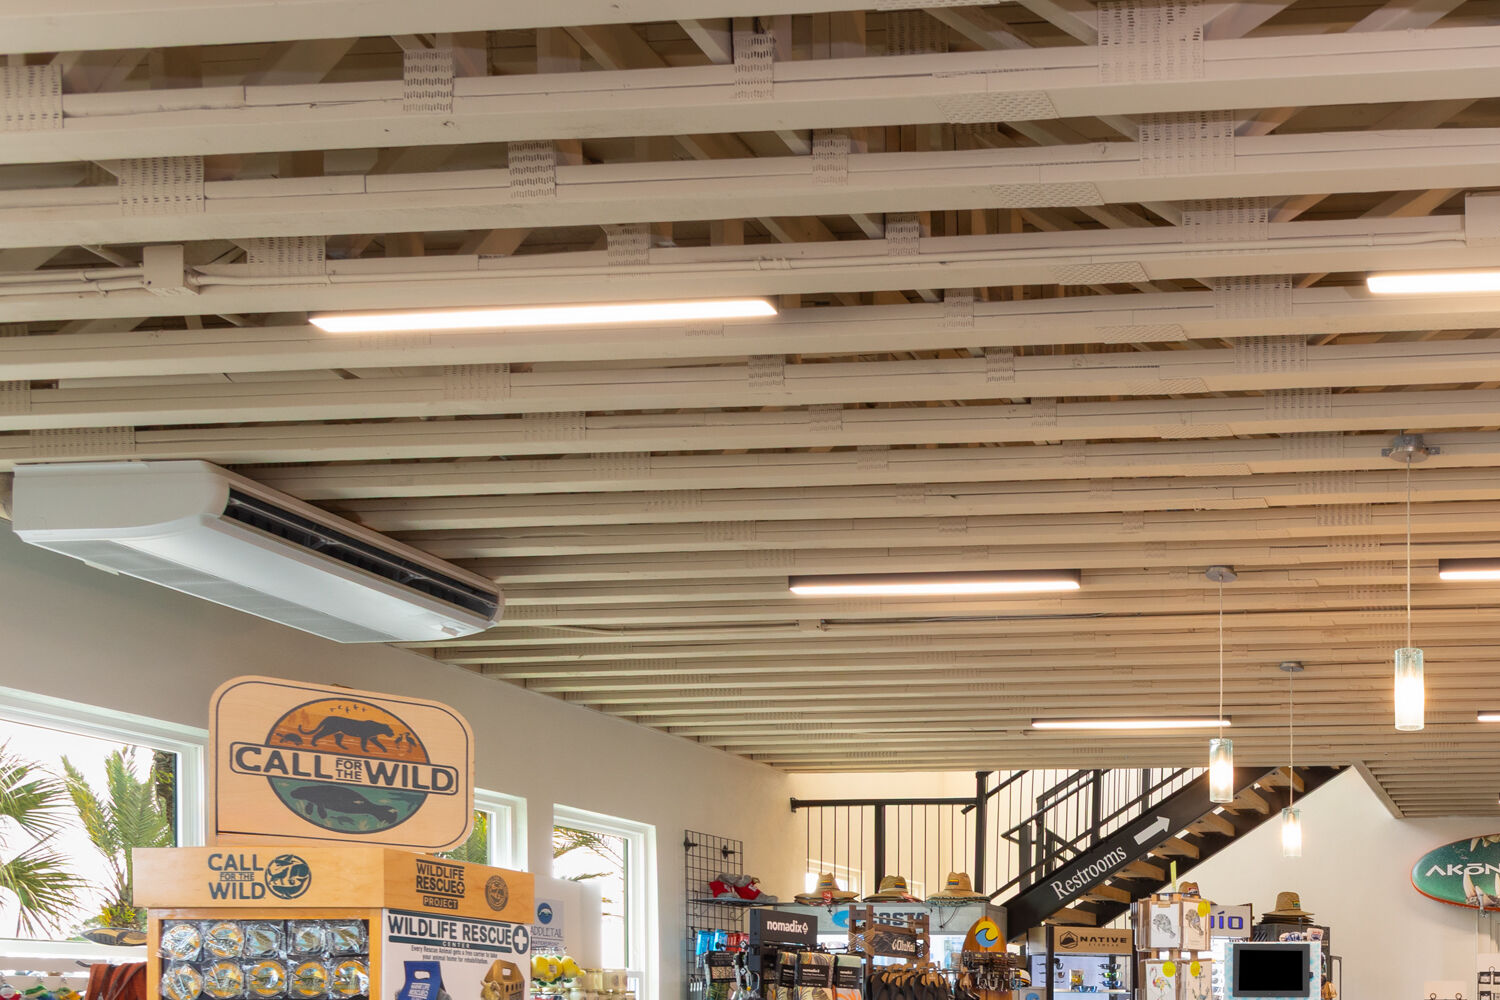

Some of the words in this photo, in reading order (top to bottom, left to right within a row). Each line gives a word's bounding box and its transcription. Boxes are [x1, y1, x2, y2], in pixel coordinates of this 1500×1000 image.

[235, 746, 334, 779] CALL
[336, 759, 362, 771] FOR
[337, 769, 362, 780] THE
[364, 760, 455, 791] WILD
[208, 853, 264, 871] CALL
[220, 872, 236, 881] FOR
[239, 873, 254, 881] THE
[416, 863, 464, 880] WILDLIFE
[1050, 846, 1127, 900] Restrooms
[208, 882, 266, 900] WILD
[416, 875, 457, 894] RESCUE
[424, 897, 458, 909] PROJECT
[388, 915, 457, 939] WILDLIFE
[463, 924, 512, 946] RESCUE
[766, 919, 802, 933] nomadix
[442, 941, 471, 949] CENTER
[1080, 936, 1127, 944] NATIVE
[411, 945, 423, 953] Every
